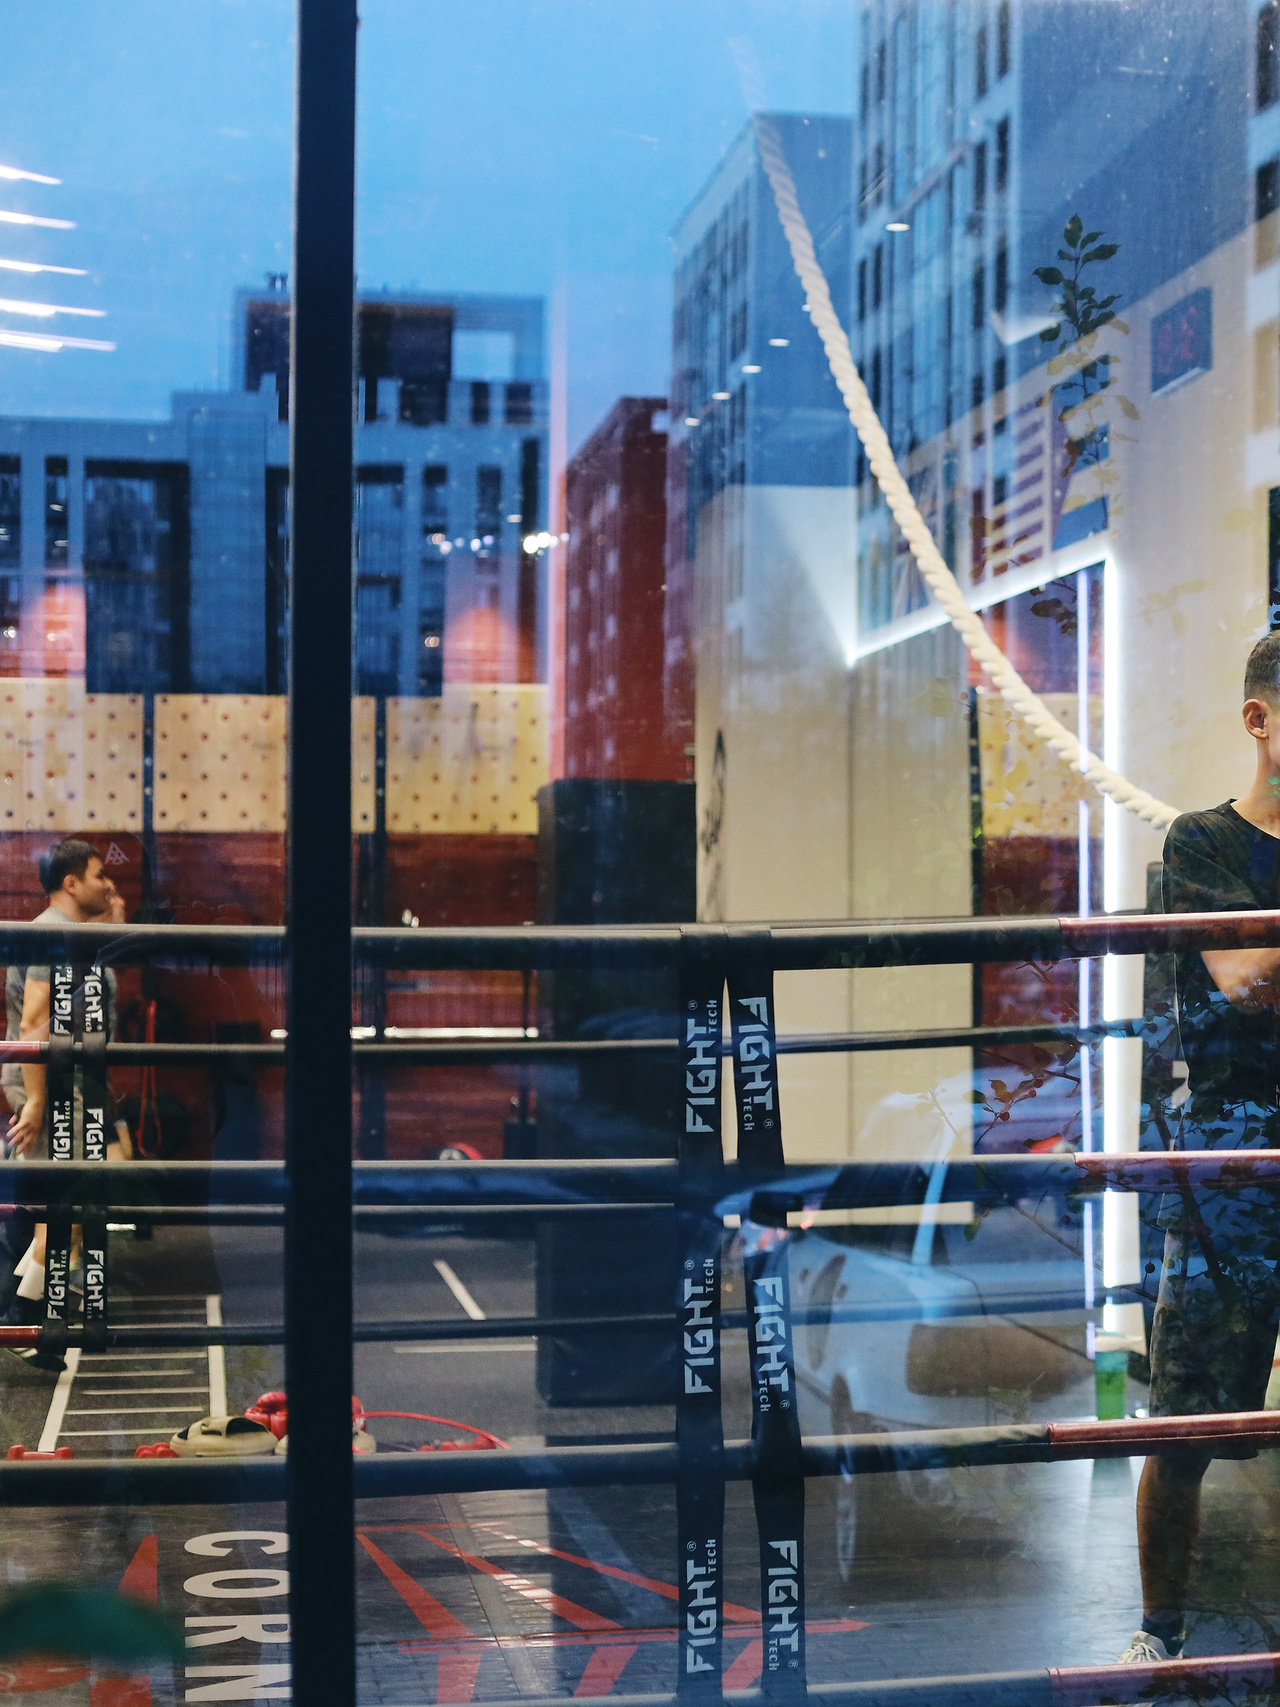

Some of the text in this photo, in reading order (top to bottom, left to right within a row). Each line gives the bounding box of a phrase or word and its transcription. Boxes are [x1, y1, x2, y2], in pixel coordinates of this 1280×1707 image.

[54, 973, 72, 1035] FIGHT
[738, 996, 773, 1111] FIGHT
[685, 1018, 717, 1133] FIGHT
[53, 1110, 71, 1162] IGHT
[86, 1107, 104, 1162] FIGH
[47, 1258, 66, 1320] FIGHT
[86, 1249, 104, 1311] FIGHT
[684, 1278, 715, 1394] FIGHT
[753, 1276, 790, 1392] FIGHT
[686, 1559, 717, 1674] FIGHT
[767, 1540, 799, 1653] FIGHT
